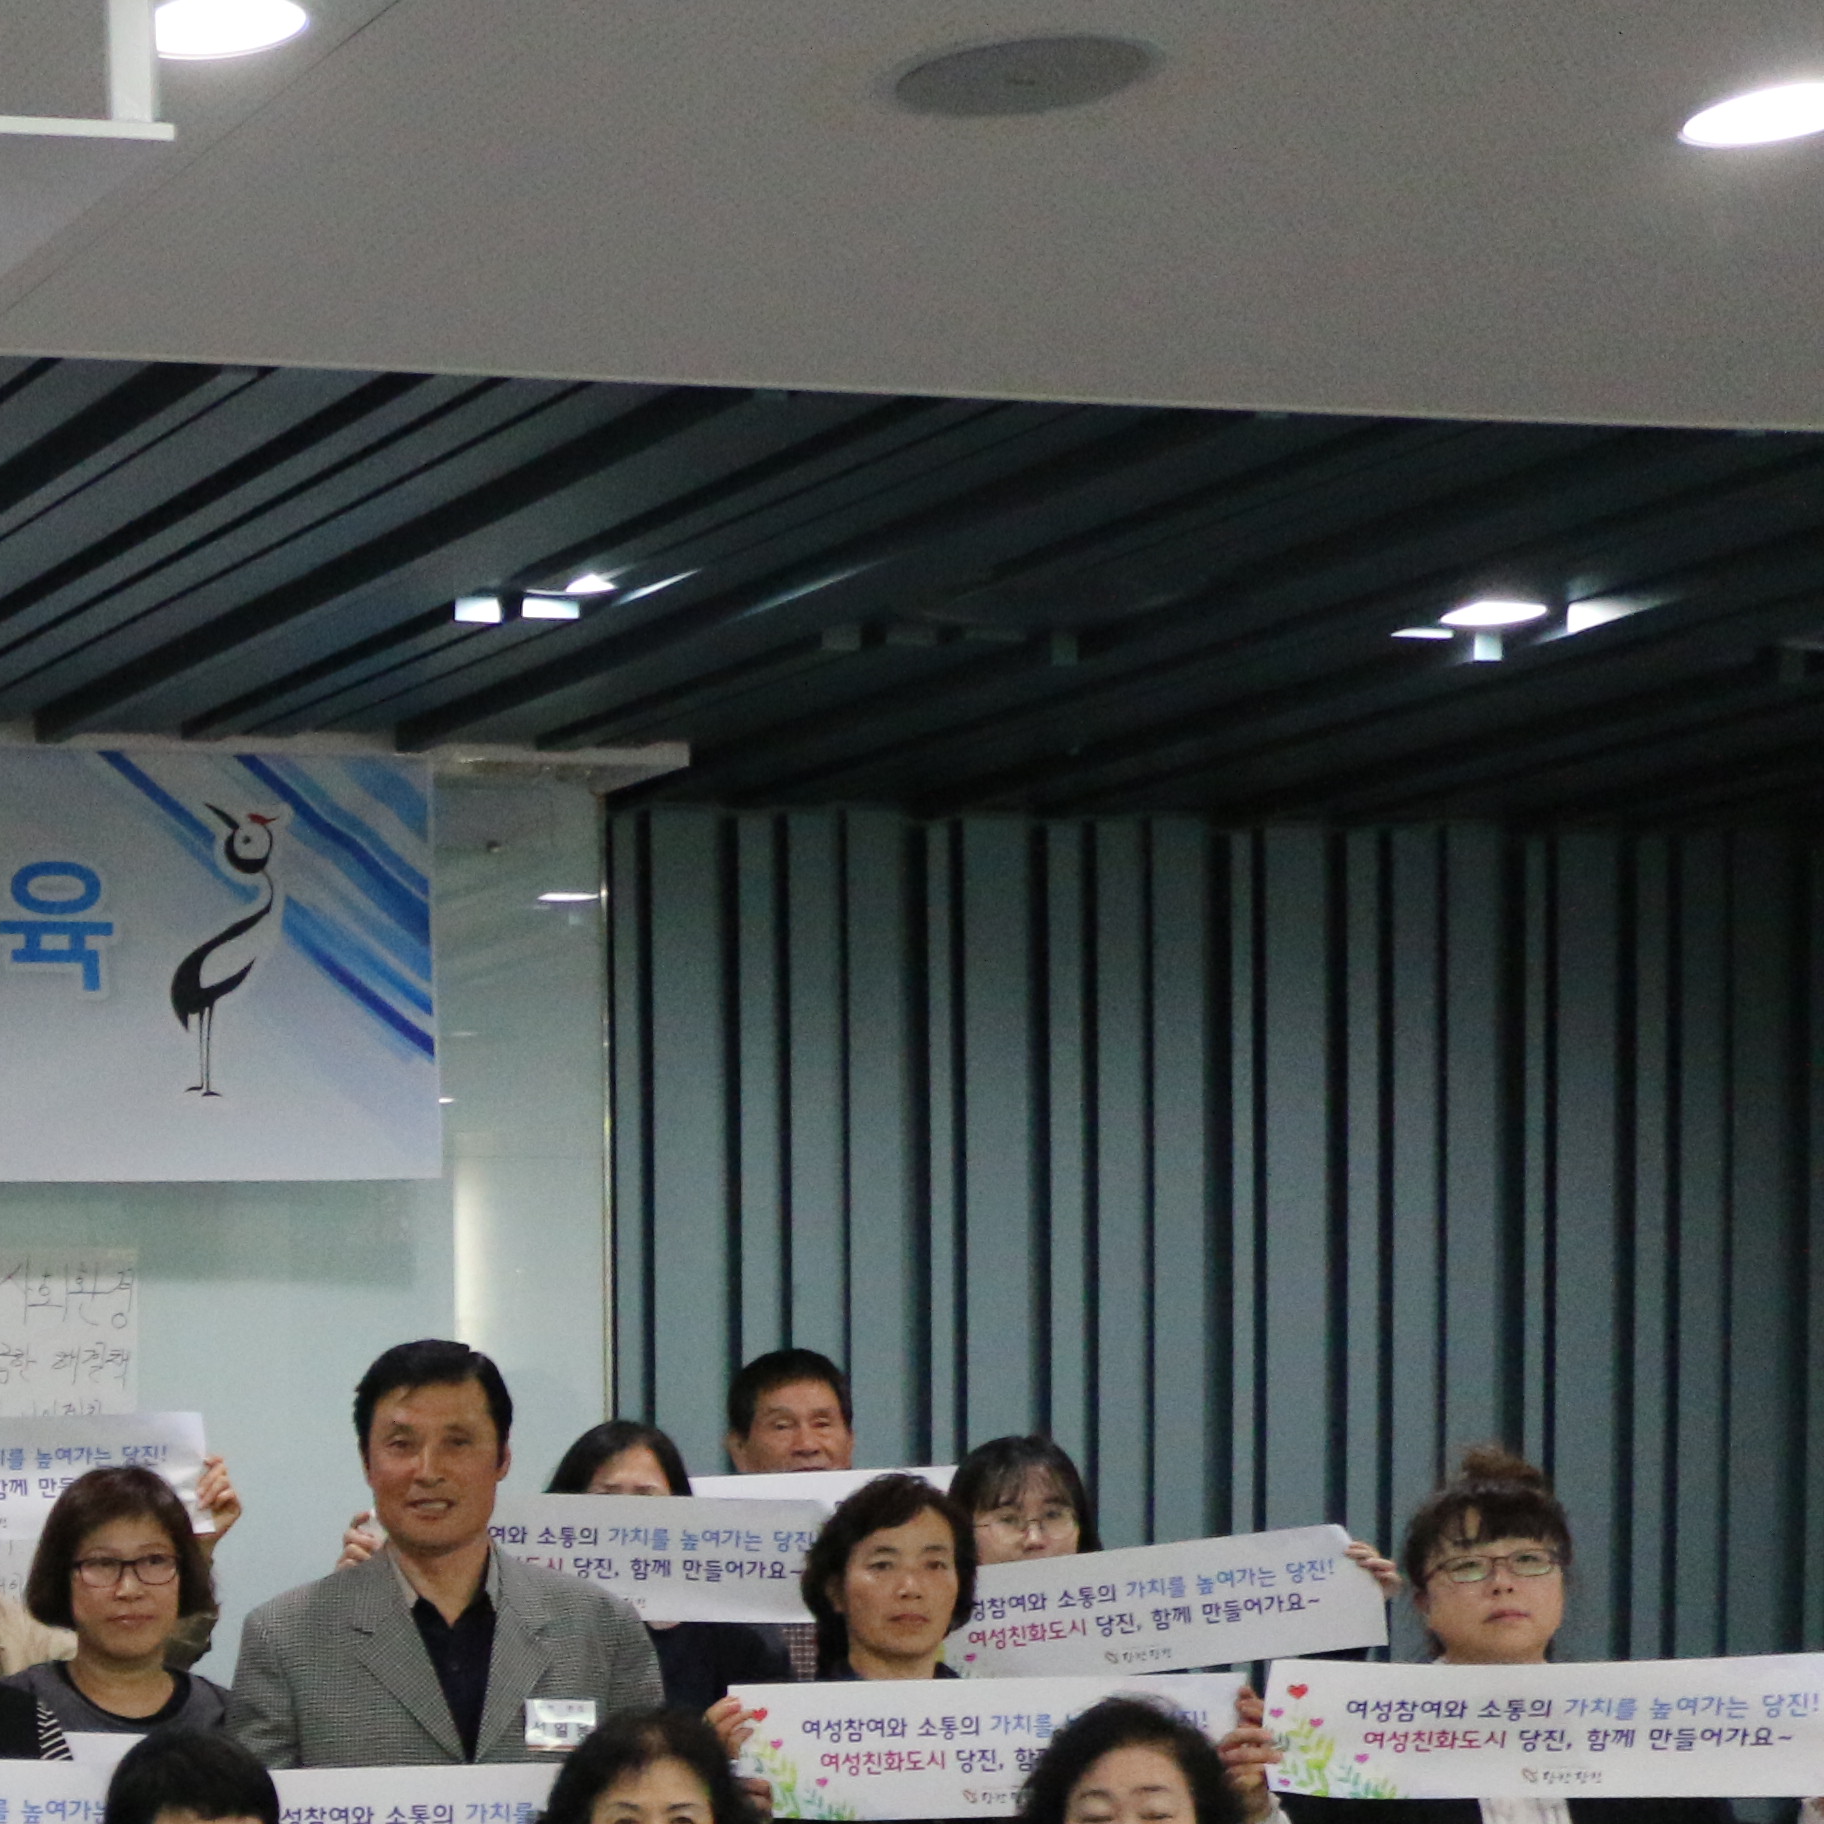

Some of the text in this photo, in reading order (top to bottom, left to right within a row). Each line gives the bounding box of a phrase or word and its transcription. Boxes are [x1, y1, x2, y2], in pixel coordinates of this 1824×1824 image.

[967, 1617, 1088, 1651] 여성친화도시
[1094, 1611, 1143, 1639] 당진,
[1150, 1604, 1193, 1632] 함께
[1345, 1692, 1819, 1724] 여성참여와 소통의 가치를 높여가는 당진!
[1362, 1725, 1793, 1754] 여성친화도시 당진, 함께 만들어가요~
